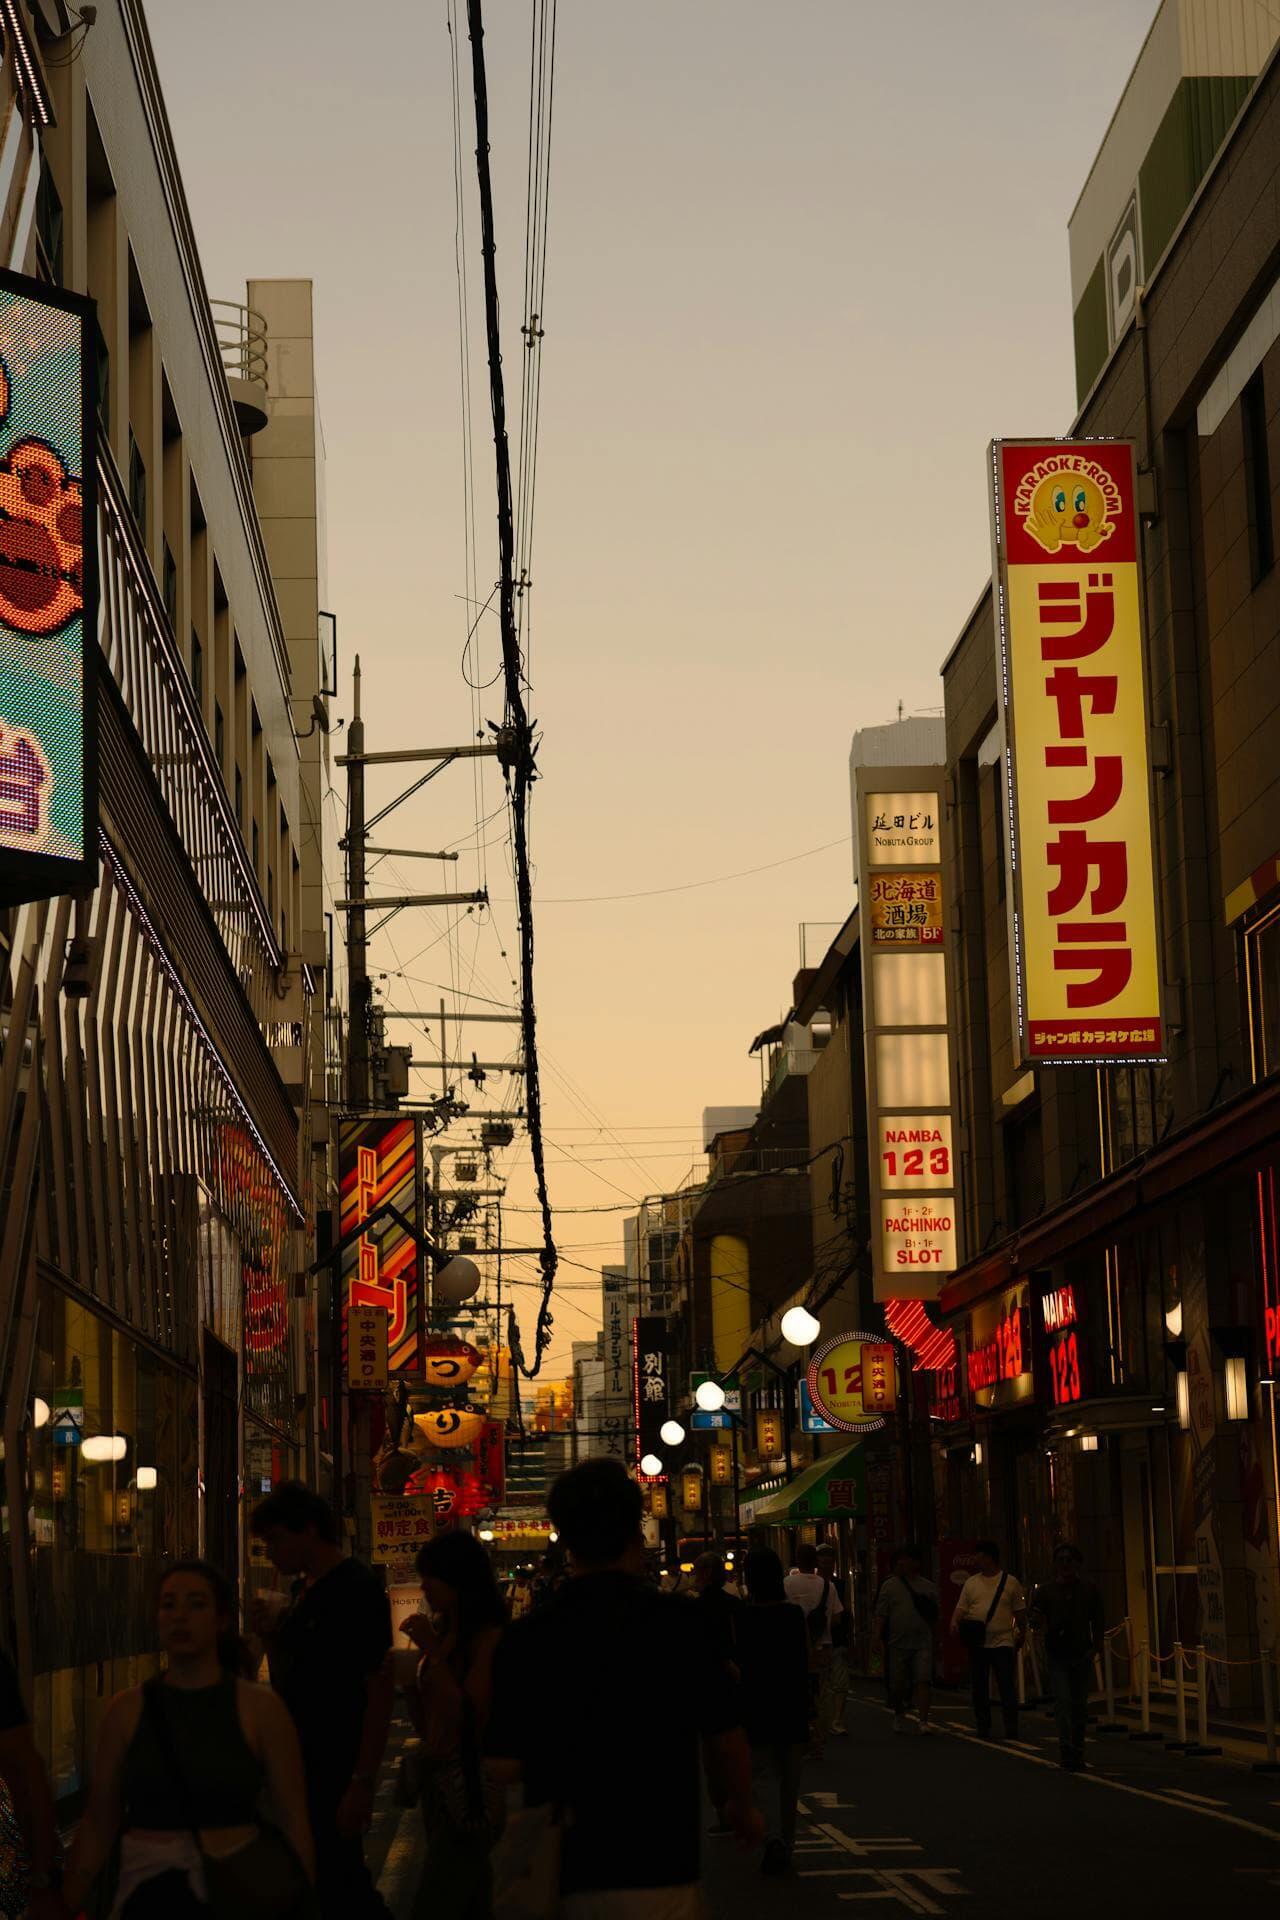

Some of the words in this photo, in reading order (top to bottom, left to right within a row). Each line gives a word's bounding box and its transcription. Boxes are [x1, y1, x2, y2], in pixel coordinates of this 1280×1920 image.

[1038, 573, 1132, 1009] ジャンカラ
[872, 812, 935, 831] 延田ビル
[872, 880, 937, 902] 北海道
[885, 904, 928, 926] 酒場
[875, 929, 917, 940] 北の家族
[922, 927, 941, 940] 5F
[1034, 1028, 1155, 1046] ジャンボカラオケ広場
[886, 1130, 942, 1143] NAMBA
[882, 1147, 949, 1176] 123
[885, 1217, 951, 1232] PACHINKO
[897, 1250, 942, 1264] SLOT
[360, 1319, 376, 1376] 中央通り
[431, 1360, 460, 1378] つ
[641, 1352, 666, 1403] 別館
[821, 1364, 863, 1394] 12
[872, 1355, 886, 1400] 中央通り
[1050, 1331, 1080, 1406] 123
[436, 1412, 460, 1435] り
[827, 1478, 857, 1511] 質
[377, 1519, 430, 1537] 朝定食
[377, 1541, 425, 1555] やってま
